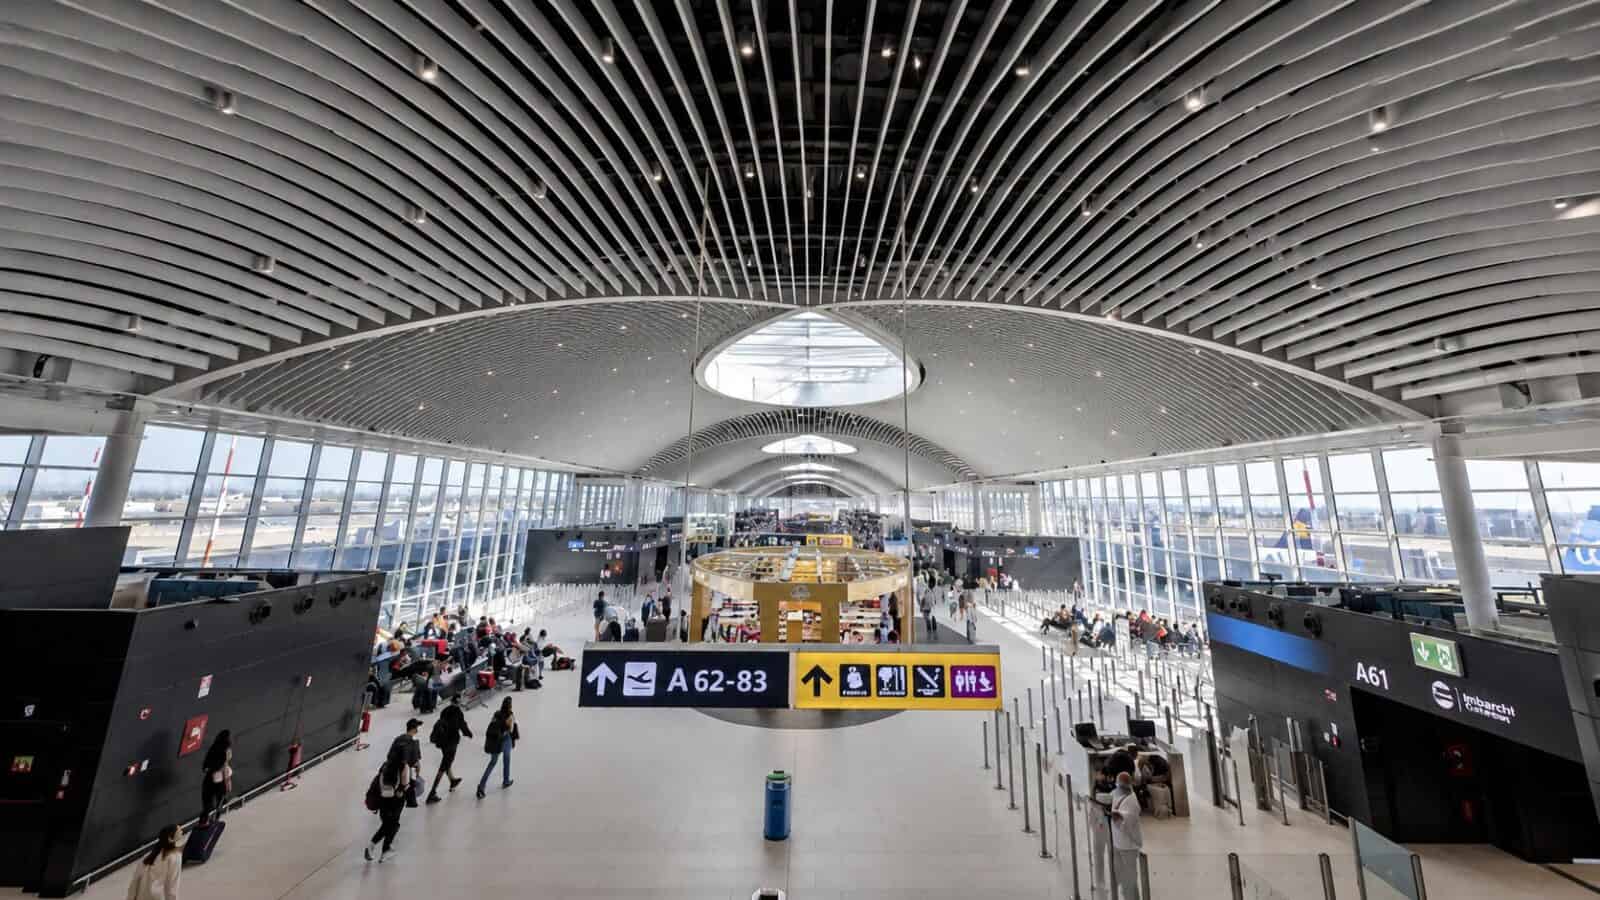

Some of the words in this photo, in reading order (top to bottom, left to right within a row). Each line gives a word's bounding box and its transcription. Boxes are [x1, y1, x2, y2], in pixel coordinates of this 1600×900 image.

[666, 667, 689, 692] A
[694, 669, 768, 692] 62-83
[1356, 661, 1389, 690] A61
